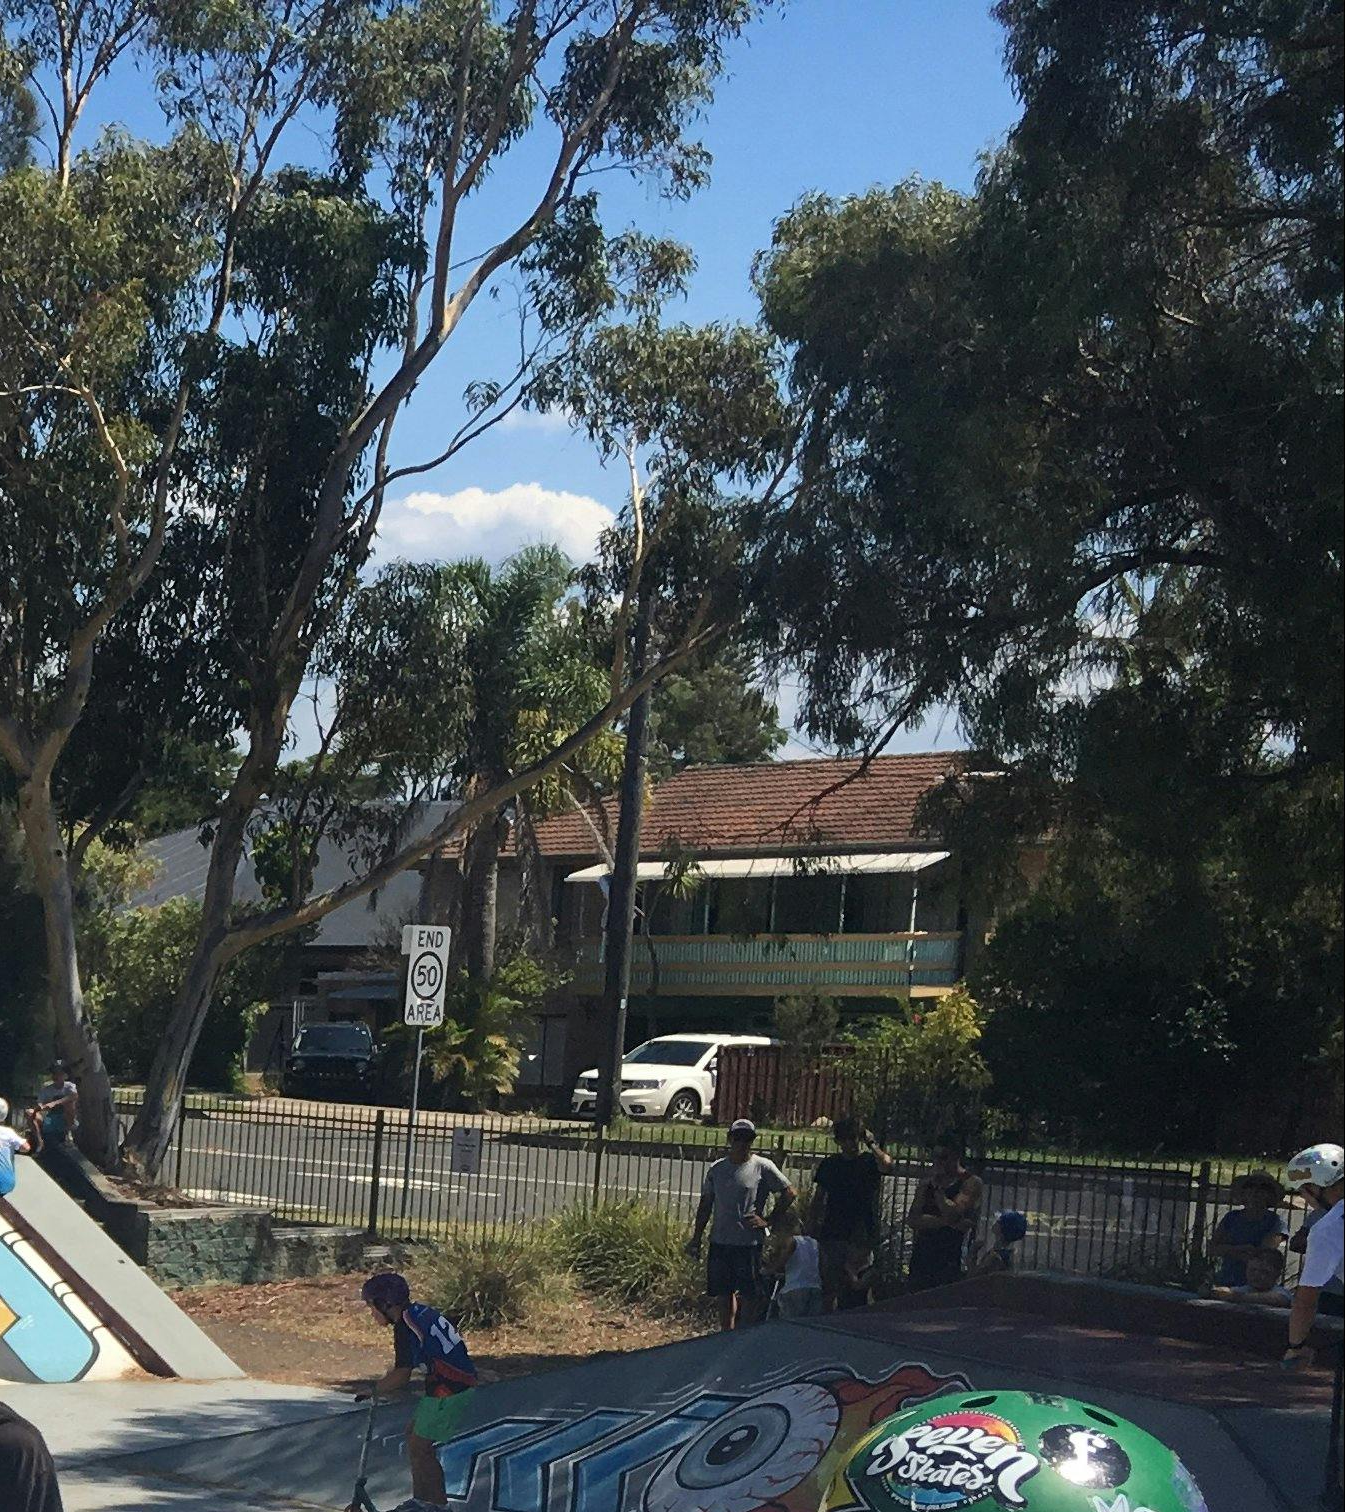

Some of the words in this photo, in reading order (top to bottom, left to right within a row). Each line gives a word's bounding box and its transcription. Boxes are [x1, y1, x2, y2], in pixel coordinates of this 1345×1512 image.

[417, 930, 444, 949] END
[416, 964, 438, 987] 50
[406, 1003, 442, 1022] AREA
[430, 1315, 463, 1355] 12
[865, 1424, 1040, 1503] Seven
[898, 1450, 994, 1490] Skates
